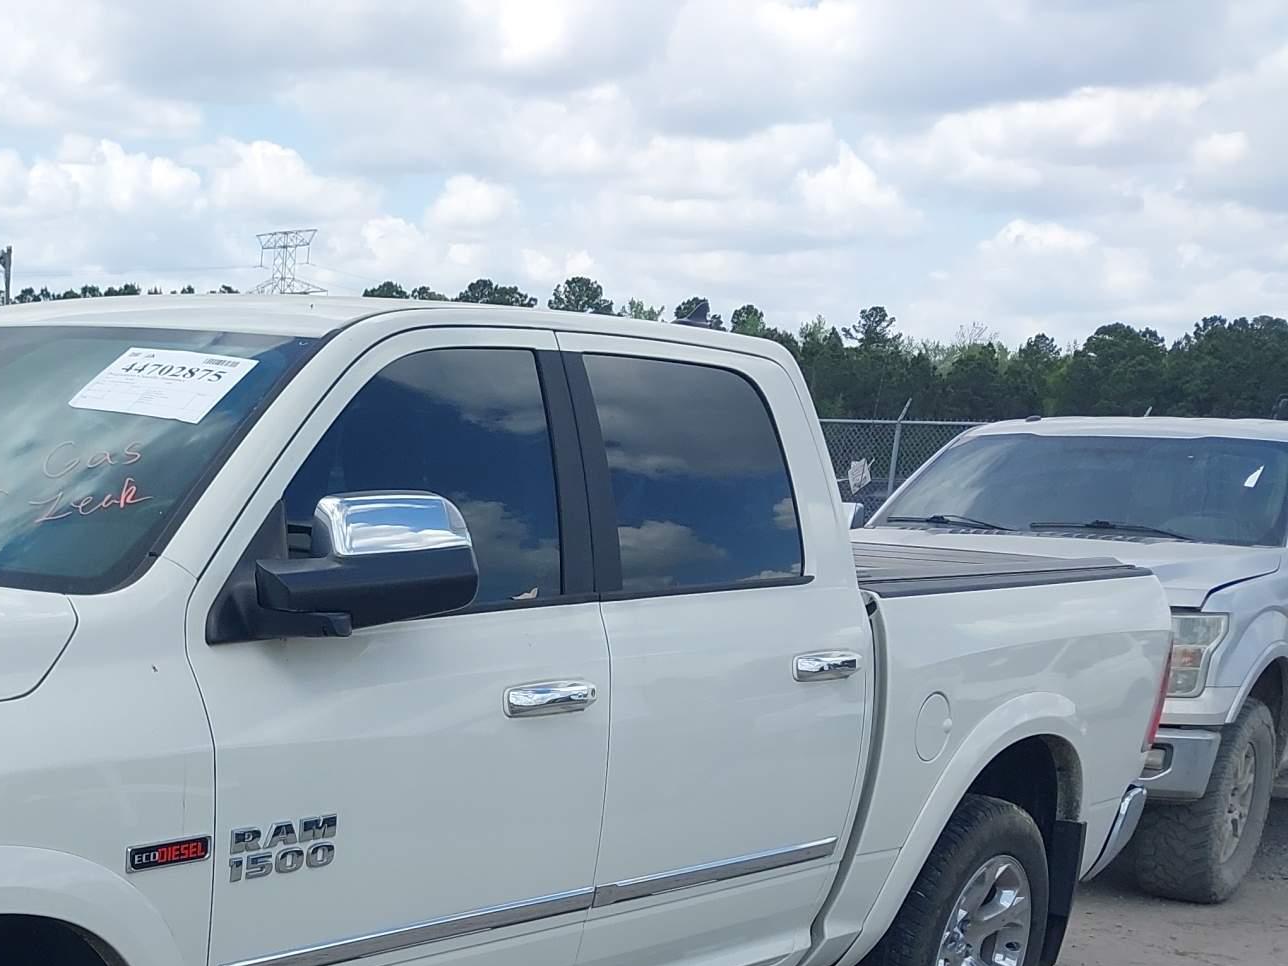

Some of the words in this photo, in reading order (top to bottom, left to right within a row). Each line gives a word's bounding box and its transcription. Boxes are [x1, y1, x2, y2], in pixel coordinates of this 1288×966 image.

[121, 361, 229, 383] 44702875
[43, 440, 144, 478] Gas
[230, 813, 338, 855] RAM
[134, 842, 206, 865] ECODIESEL
[228, 841, 336, 883] 1500
